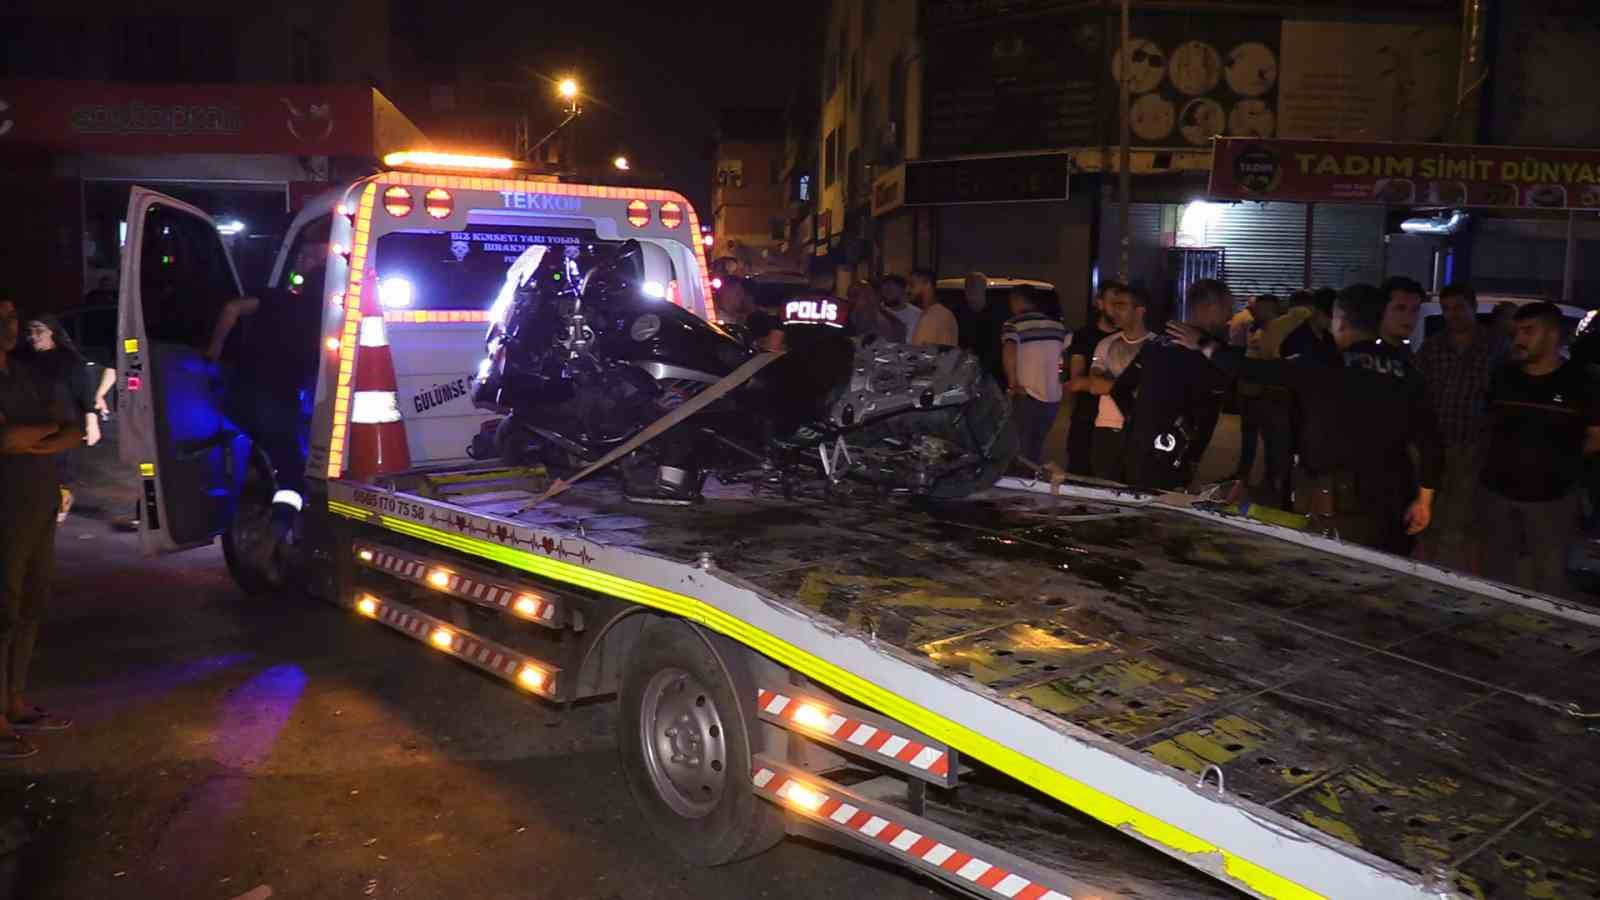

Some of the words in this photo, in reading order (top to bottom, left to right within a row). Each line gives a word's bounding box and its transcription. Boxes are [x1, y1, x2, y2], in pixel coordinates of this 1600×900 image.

[1296, 152, 1415, 176] TADIM
[1421, 152, 1494, 182] SİMİT
[786, 300, 837, 320] POLİS
[414, 379, 467, 413] GÜLÜMSE
